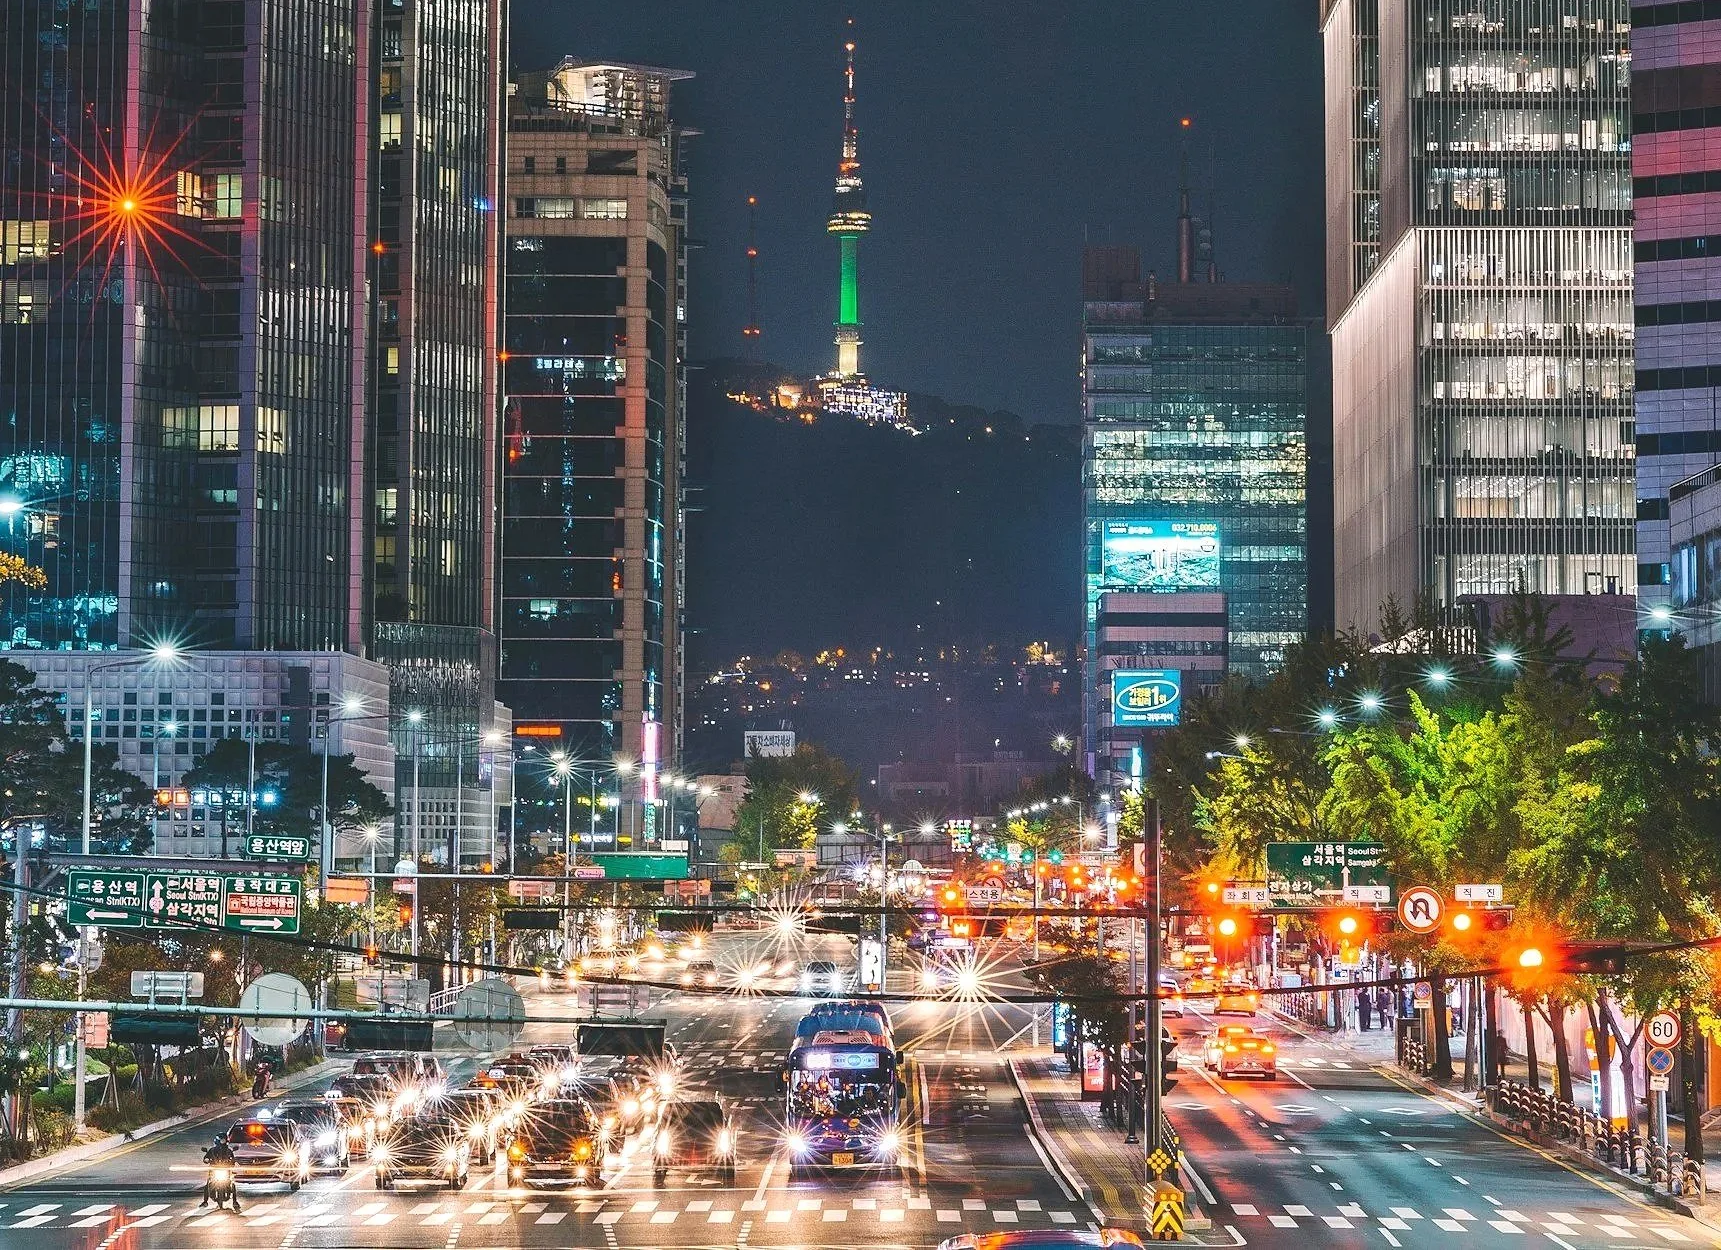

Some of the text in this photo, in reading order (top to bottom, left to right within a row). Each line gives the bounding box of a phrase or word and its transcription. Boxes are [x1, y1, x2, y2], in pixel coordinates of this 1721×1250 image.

[251, 838, 304, 855] 용산역앞
[1314, 844, 1345, 855] 서울역
[1301, 855, 1345, 866] 삼각지역
[92, 879, 138, 895] 용산역
[181, 877, 220, 892] 서울역
[234, 878, 291, 893] 동작대교
[1269, 881, 1313, 891] 전자상가
[166, 890, 187, 900] Seoul
[240, 895, 294, 908] 국립중앙박물관
[166, 902, 219, 918] 삼각지역
[1652, 1021, 1673, 1038] 60
